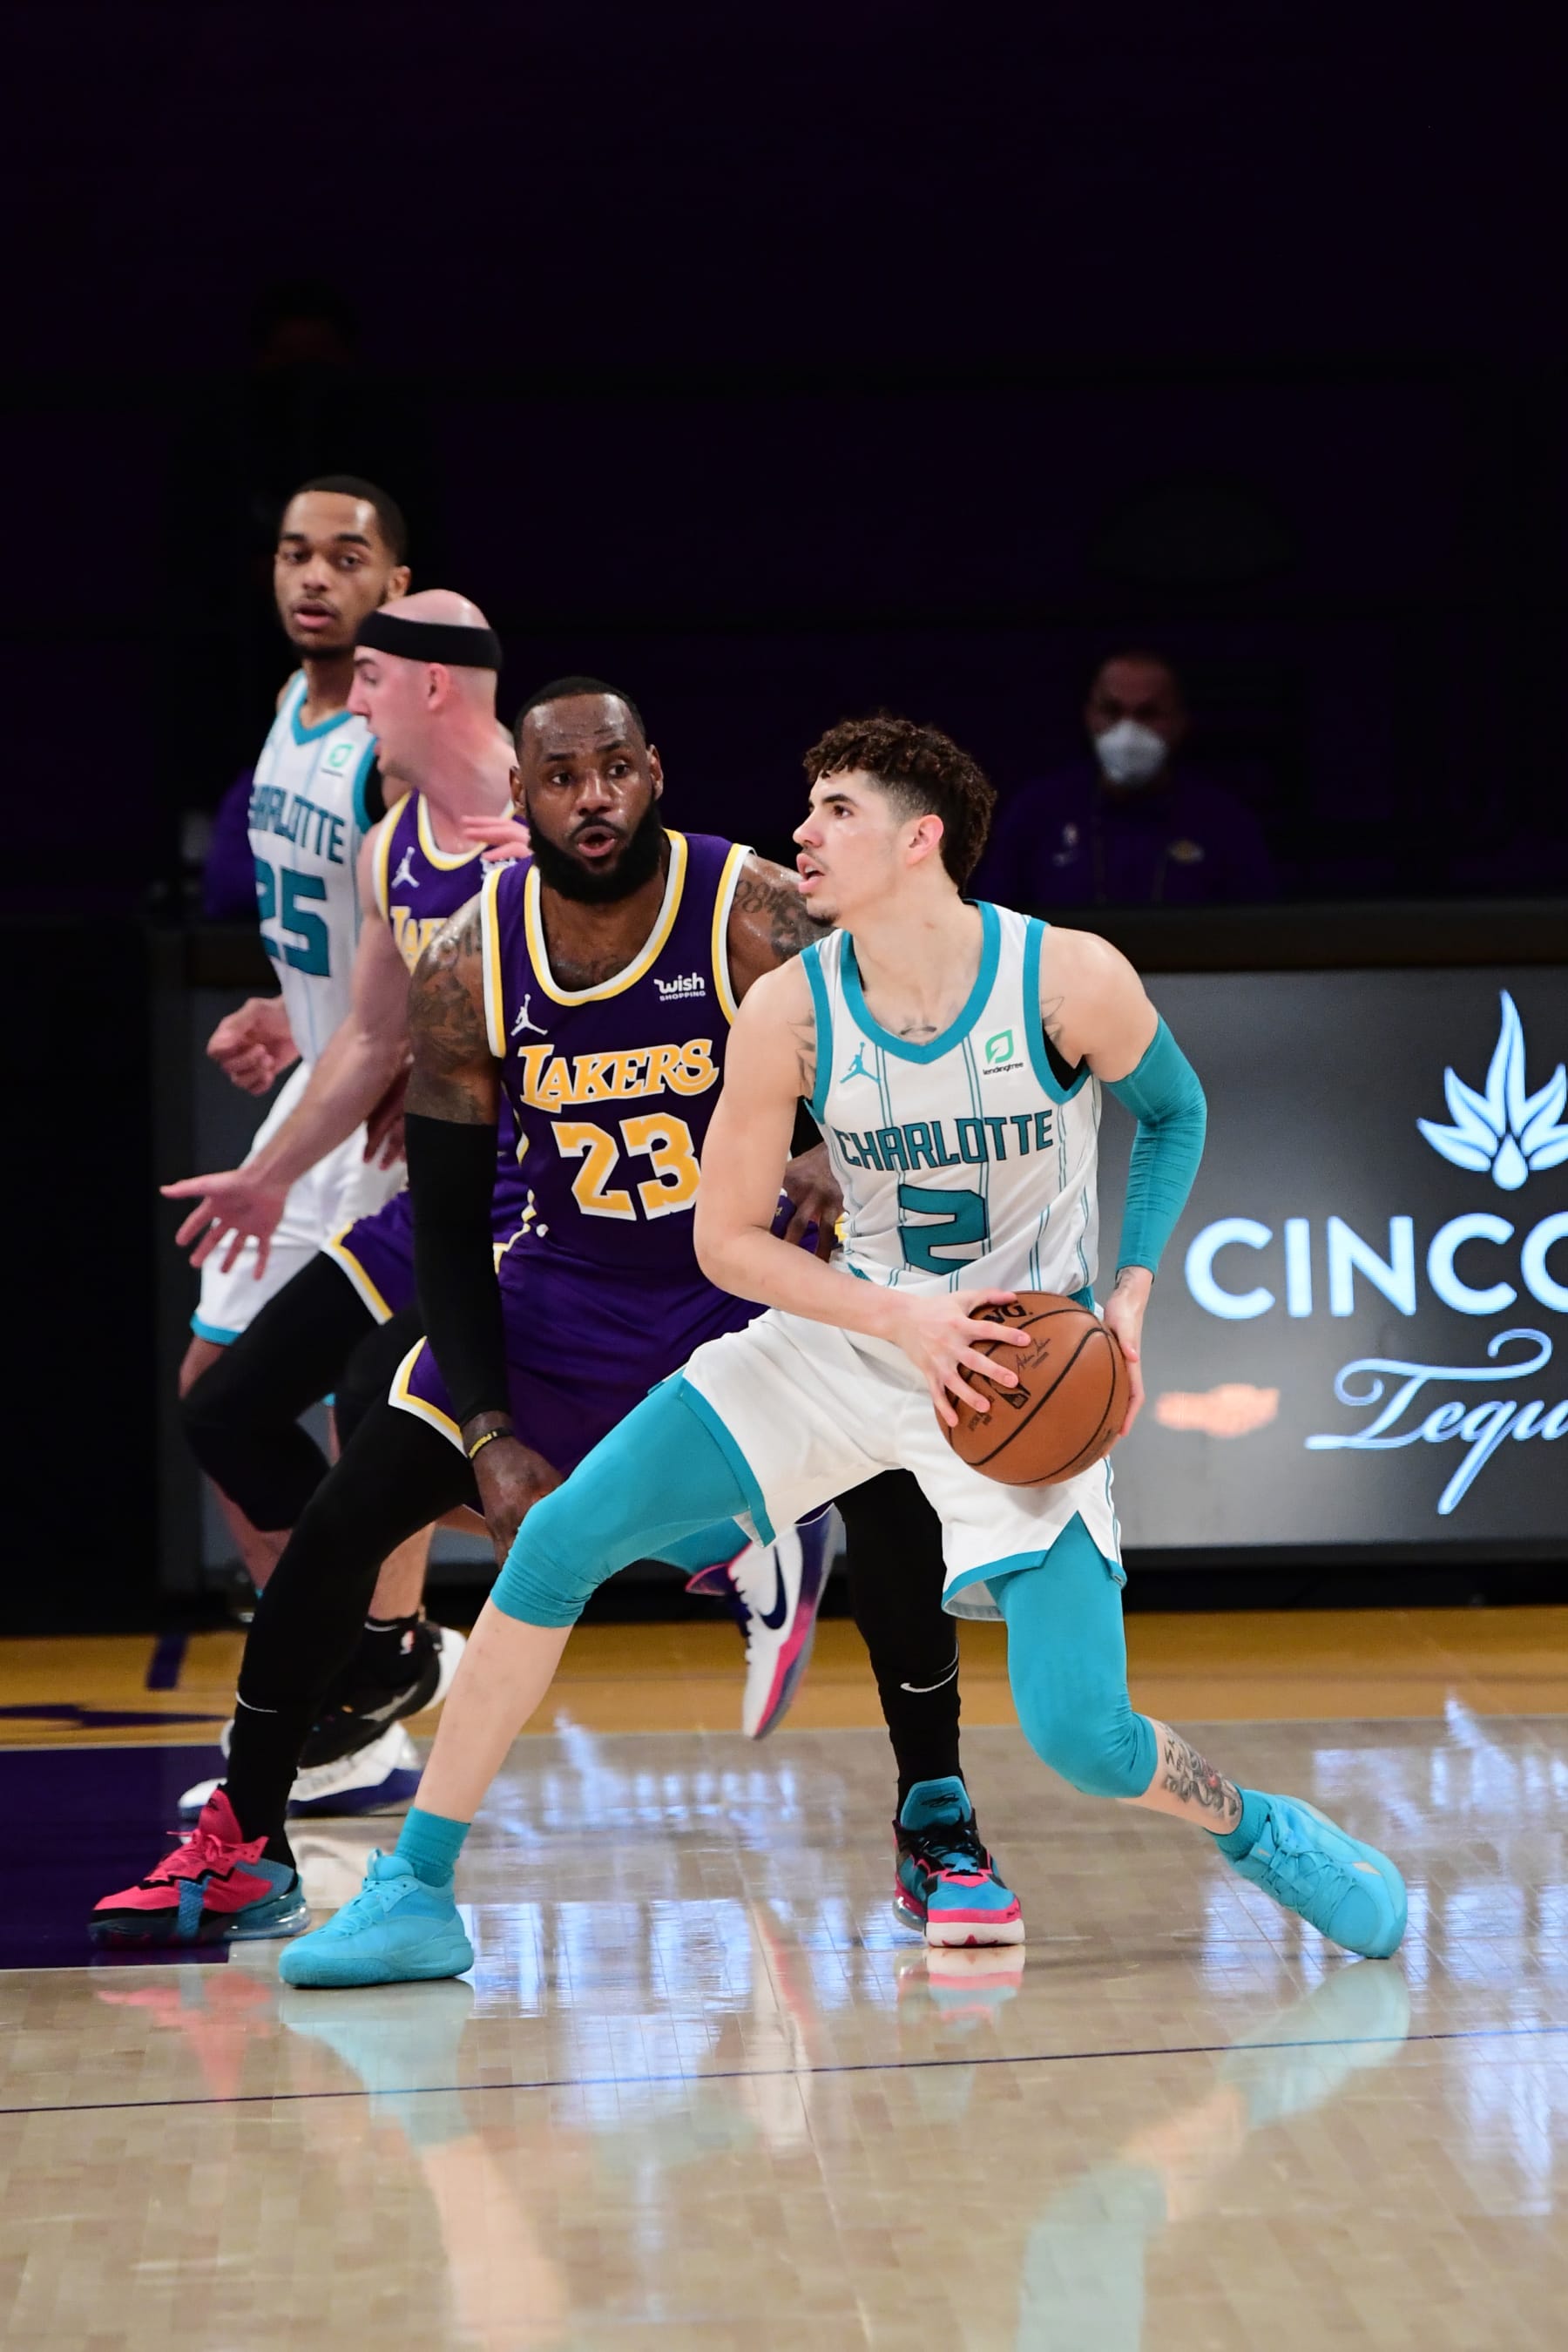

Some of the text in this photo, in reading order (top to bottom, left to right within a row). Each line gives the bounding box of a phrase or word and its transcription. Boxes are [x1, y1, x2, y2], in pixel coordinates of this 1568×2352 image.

[254, 856, 331, 977] 25
[653, 971, 705, 994] wish
[659, 990, 706, 1002] SHOPPING
[517, 1038, 720, 1113] LAKERS
[983, 1062, 1024, 1076] lendingtree
[551, 1112, 701, 1221] 23
[832, 1109, 1052, 1172] CHARLOTTE
[897, 1183, 987, 1275] 2
